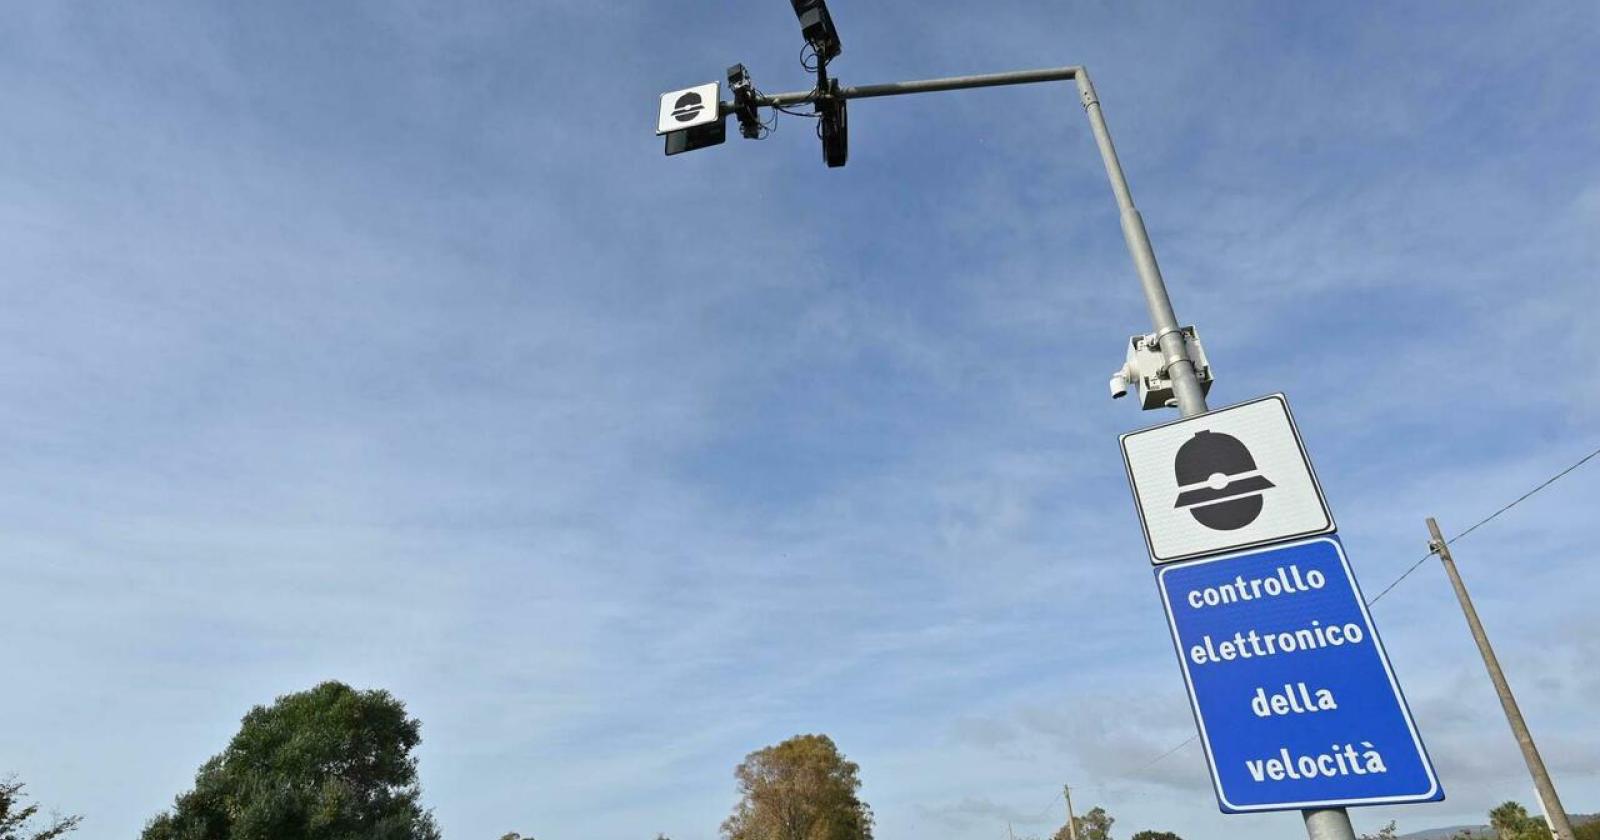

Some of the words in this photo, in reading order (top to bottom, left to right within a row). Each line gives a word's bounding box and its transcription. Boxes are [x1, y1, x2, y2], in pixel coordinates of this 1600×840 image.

[1188, 565, 1326, 609] controllo
[1190, 620, 1363, 665] elettronico
[1251, 683, 1338, 717] della
[1246, 742, 1387, 782] velocità
